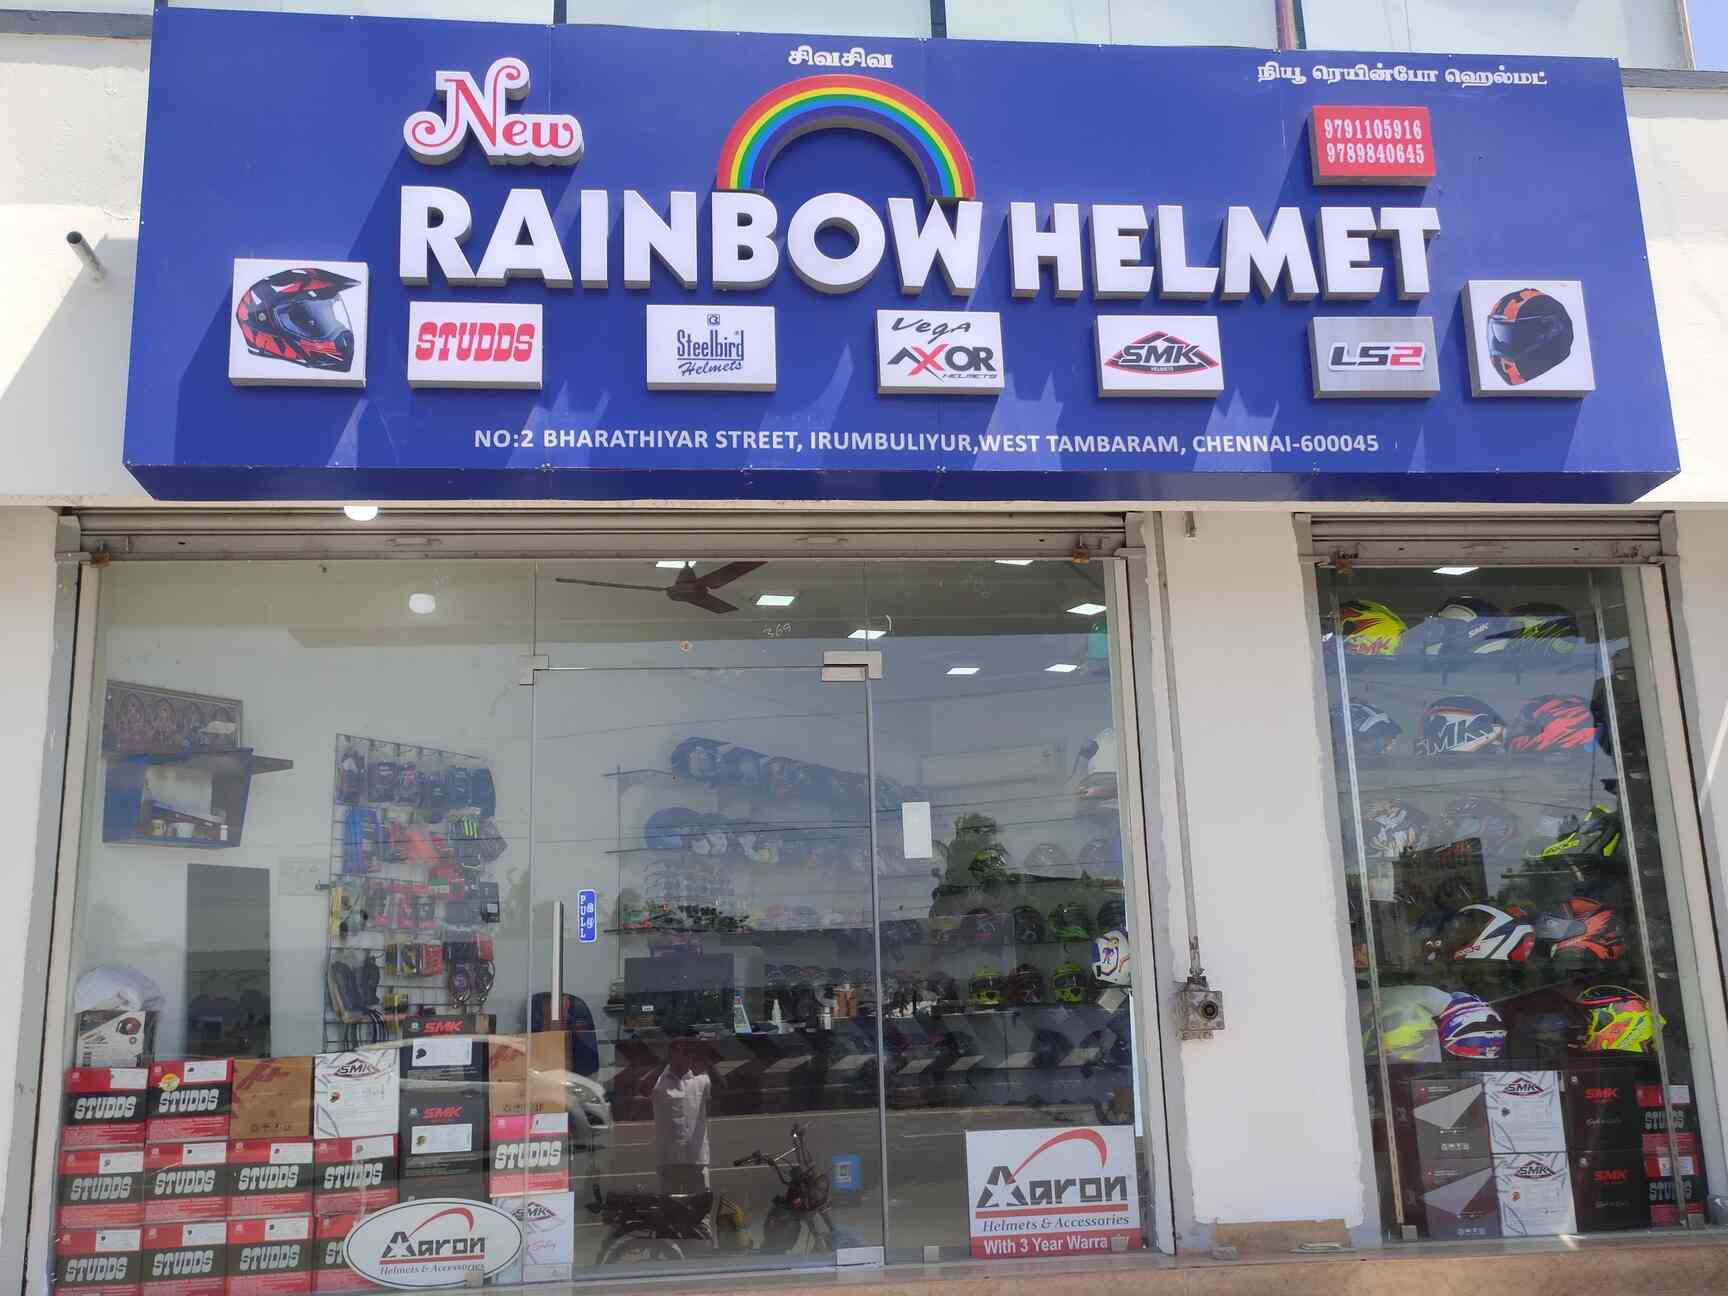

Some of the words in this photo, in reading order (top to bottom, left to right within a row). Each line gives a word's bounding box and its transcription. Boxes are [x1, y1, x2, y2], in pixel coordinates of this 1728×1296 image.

[787, 44, 895, 69] சிவசிவ
[1256, 61, 1307, 85] நியூ
[406, 60, 582, 154] New
[1323, 118, 1423, 140] 9791105916
[1325, 143, 1425, 164] 9789840645
[400, 185, 983, 292] RAINBOW
[1010, 201, 1441, 297] HELMET
[414, 321, 536, 362] STUDDS
[676, 328, 745, 360] Steelbird
[1119, 344, 1201, 364] SMK
[678, 361, 743, 376] Helmets
[886, 343, 997, 378] AXOR
[1330, 346, 1424, 367] LS2
[475, 430, 533, 448] NO:2
[543, 430, 709, 448] BHARATHIYAR
[715, 430, 802, 452] STREET,
[1045, 434, 1186, 455] TAMBARAM,
[1192, 435, 1379, 452] CHENNAI-600045
[423, 1020, 464, 1034] SMK
[1508, 1083, 1537, 1092] SMK
[1584, 1087, 1618, 1099] SMK
[74, 1096, 137, 1120] STUDDS
[159, 1088, 220, 1113] STUDDS
[422, 1106, 464, 1119] SMK
[495, 1141, 562, 1170] STUDDS
[154, 1170, 216, 1195] STUDDS
[238, 1165, 299, 1191] STUDDS
[324, 1162, 384, 1190] STUDDS
[1519, 1167, 1548, 1175] SMK
[70, 1176, 133, 1201] STUDDS
[983, 1219, 1037, 1233] Helmets
[1041, 1219, 1053, 1229] &
[1055, 1213, 1129, 1228] Accessories
[240, 1244, 301, 1271] STUDDS
[984, 1239, 1017, 1256] With
[1020, 1240, 1028, 1252] 3
[1032, 1237, 1064, 1252] Year
[65, 1257, 128, 1283] STUDDS
[152, 1250, 214, 1276] STUDDS
